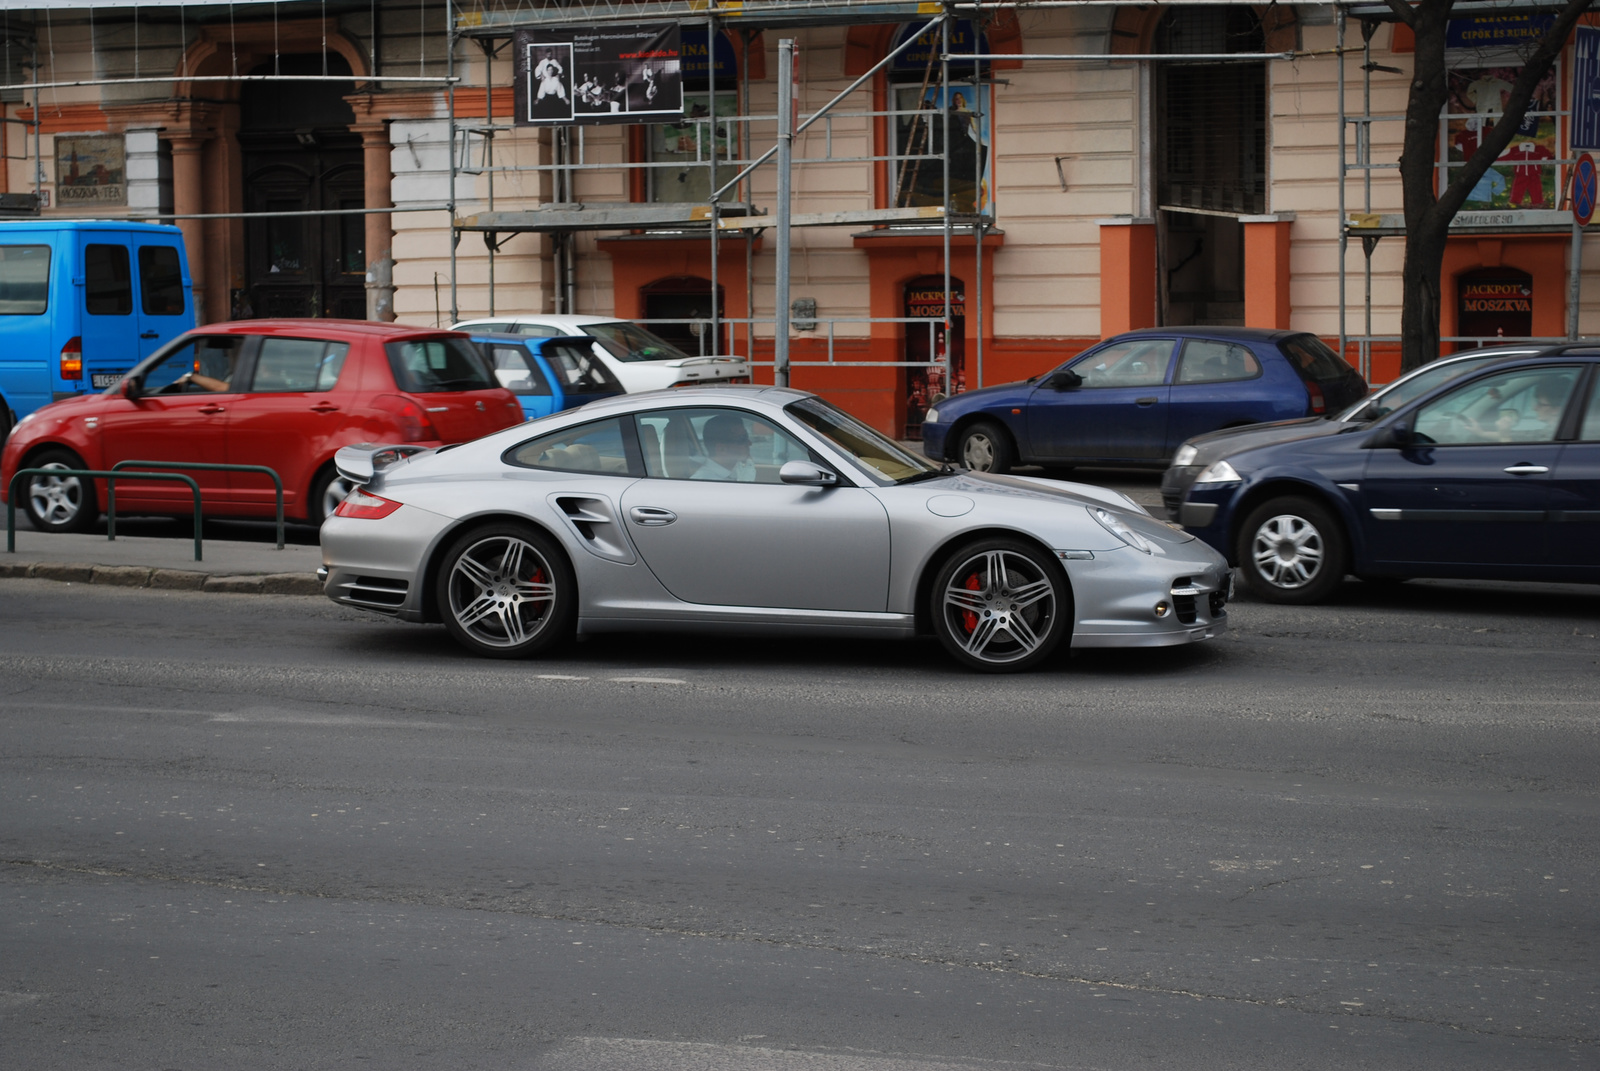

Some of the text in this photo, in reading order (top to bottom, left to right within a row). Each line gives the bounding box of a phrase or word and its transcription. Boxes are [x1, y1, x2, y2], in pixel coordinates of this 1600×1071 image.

[1466, 285, 1518, 295] JACKPOT
[910, 305, 966, 316] MOSZVA
[1464, 300, 1531, 311] MOSZKVA
